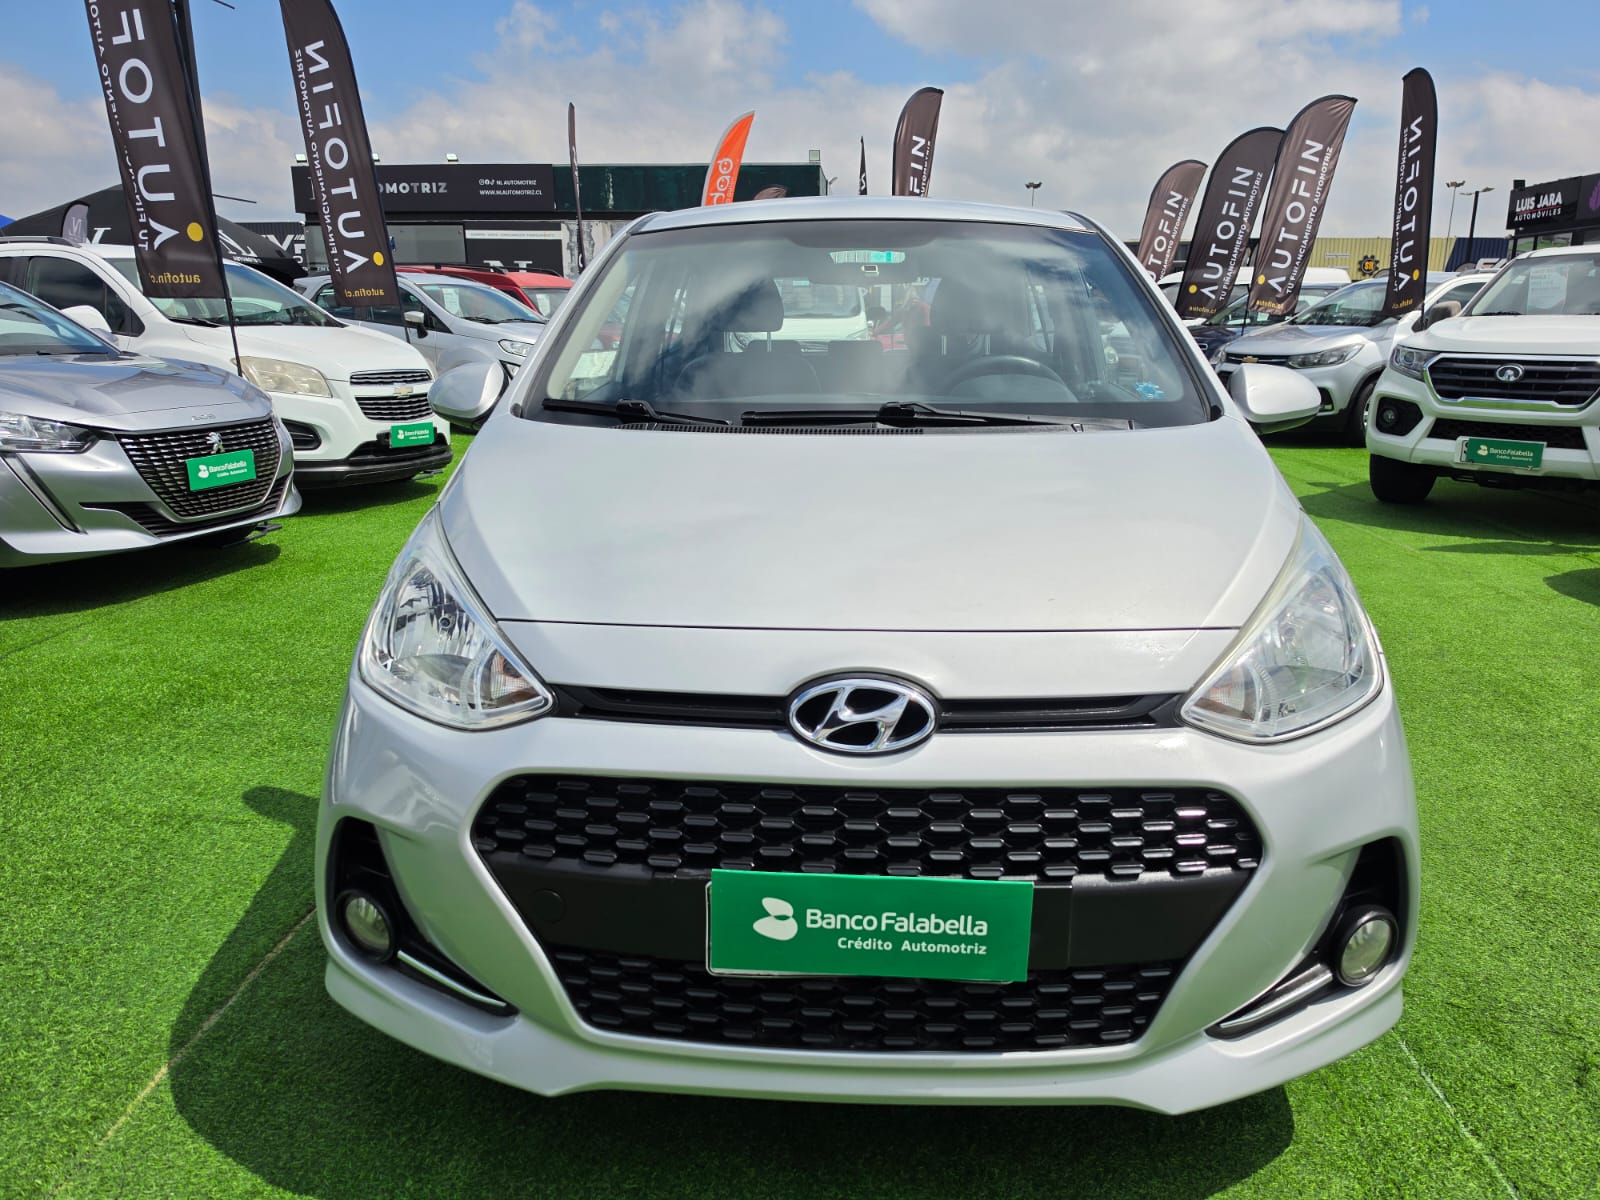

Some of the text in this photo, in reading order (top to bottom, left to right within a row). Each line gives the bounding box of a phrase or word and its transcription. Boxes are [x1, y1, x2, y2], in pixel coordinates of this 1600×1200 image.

[1242, 171, 1264, 223] AUTOMOTRIZ
[1311, 146, 1334, 204] AUTOMOTRIZ
[1515, 191, 1563, 212] LUIS JARA
[1200, 166, 1254, 300] AUTOFIN
[1268, 139, 1324, 293] AUTOFIN
[837, 936, 988, 955] Crédito Automotriz
